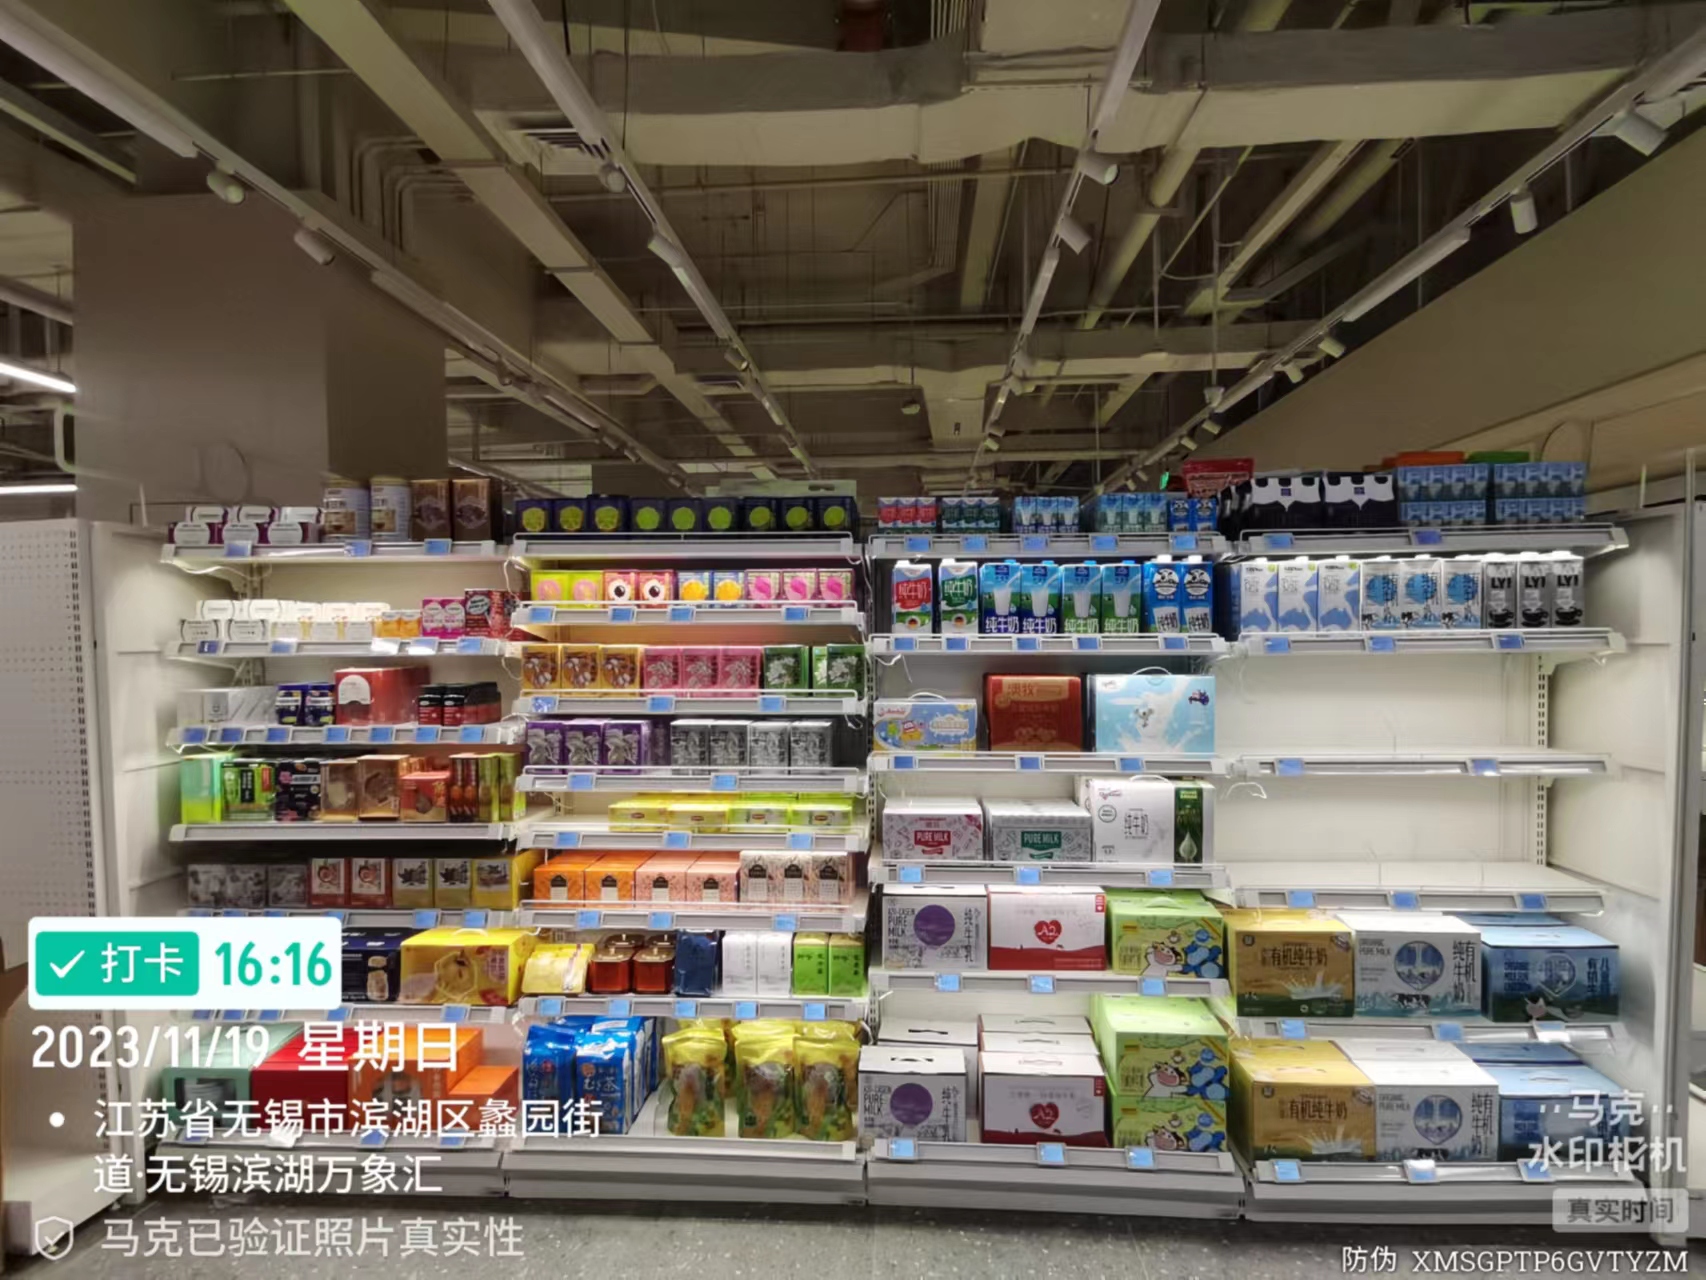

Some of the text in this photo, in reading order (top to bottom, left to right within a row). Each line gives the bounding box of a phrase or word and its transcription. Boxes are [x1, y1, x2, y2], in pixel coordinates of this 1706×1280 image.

[985, 616, 1020, 633] 纯牛奶
[1022, 617, 1057, 634] 纯牛奶
[1064, 617, 1099, 633] 纯牛奶
[1103, 617, 1139, 633] 纯牛奶
[916, 831, 949, 842] PURE MILK
[1023, 833, 1060, 844] PURE MILK
[888, 916, 908, 927] PURE
[888, 927, 906, 938] MILK
[863, 1093, 883, 1104] PURE
[863, 1104, 882, 1117] MILK
[1290, 1099, 1348, 1121] 有机纯牛奶
